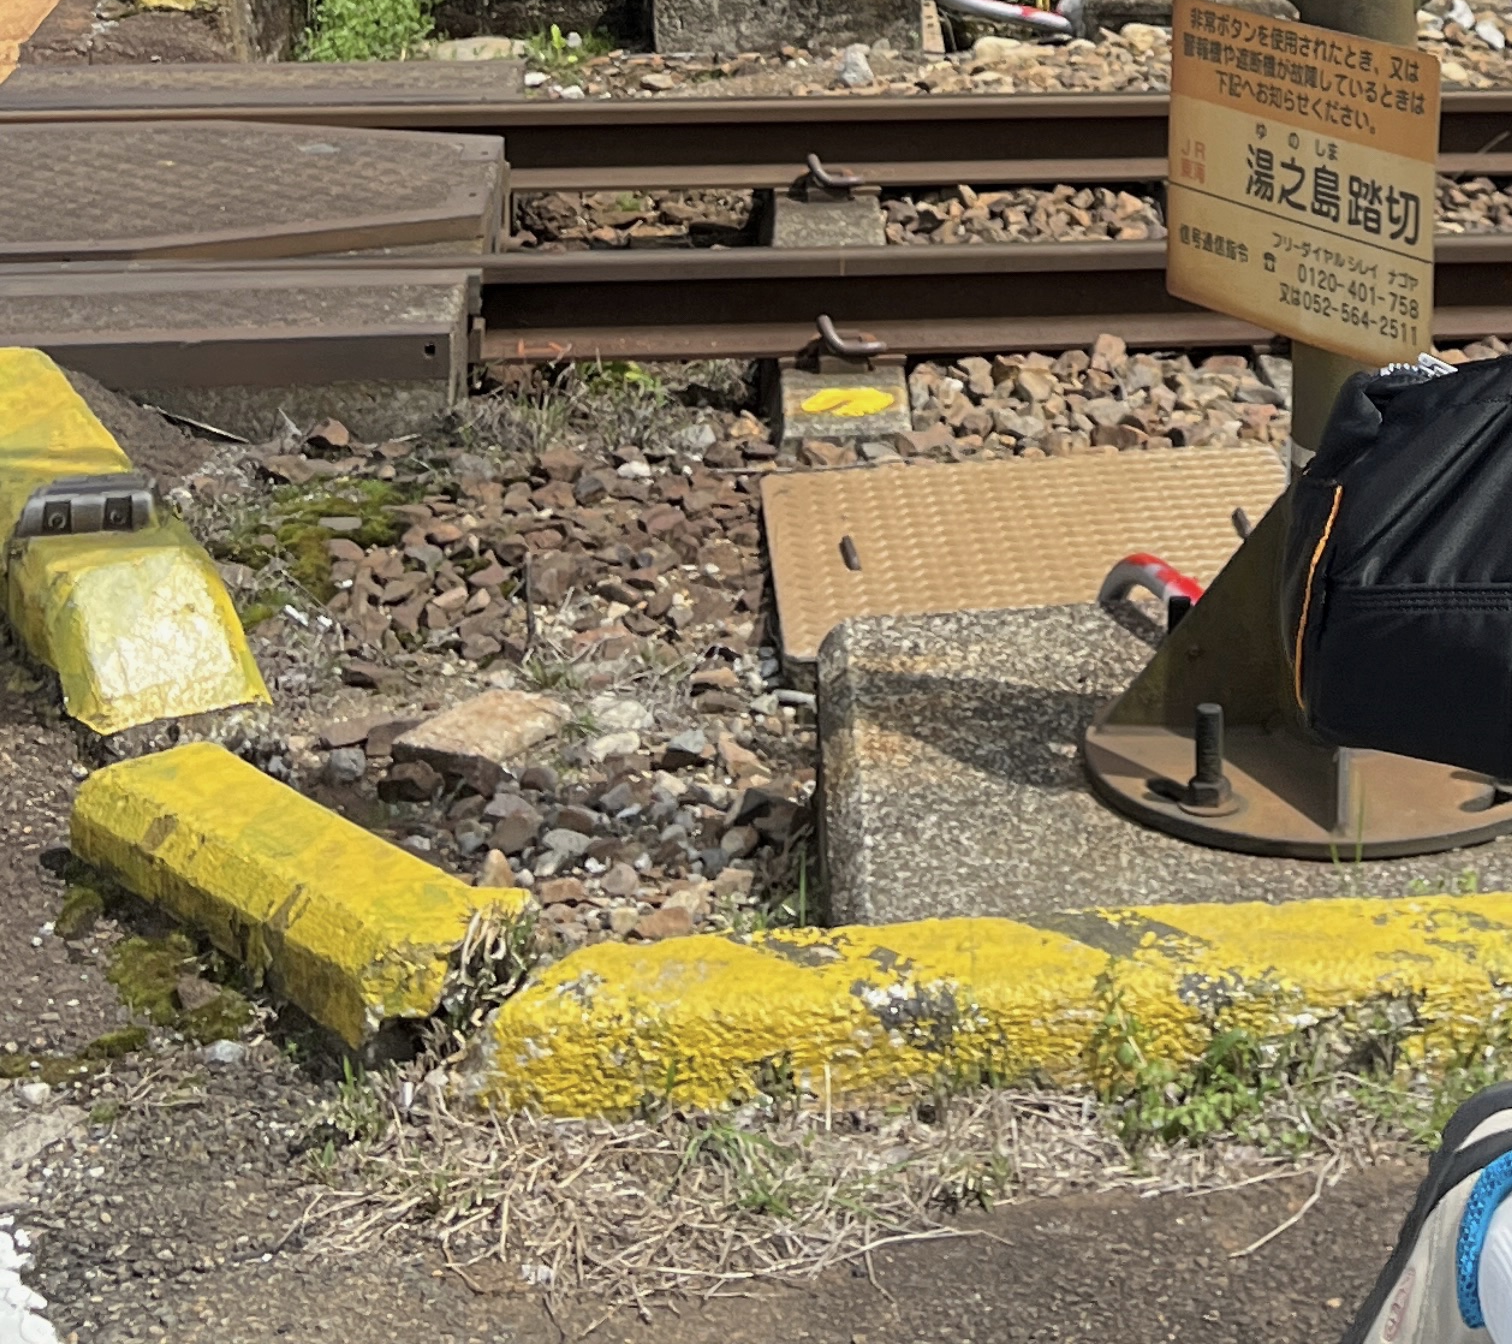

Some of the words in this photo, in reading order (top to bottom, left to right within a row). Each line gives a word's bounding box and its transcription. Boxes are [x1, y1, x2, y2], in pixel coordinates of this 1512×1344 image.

[1181, 139, 1206, 161] JR
[1246, 143, 1420, 246] 湯之島踏切
[1297, 263, 1419, 320] 0120-401-758
